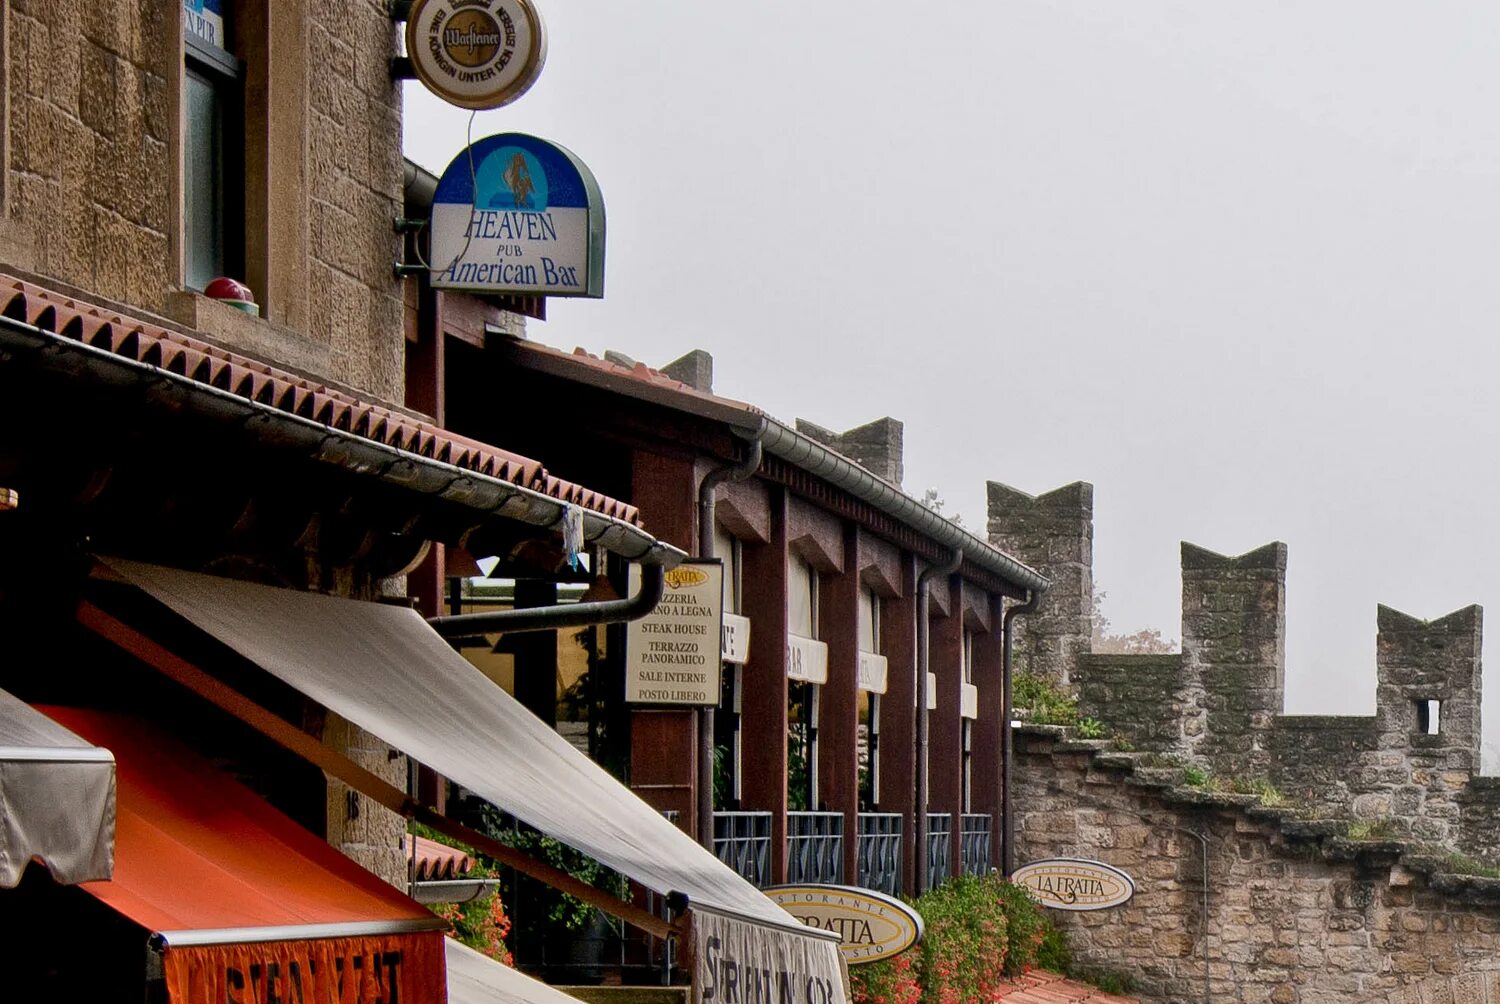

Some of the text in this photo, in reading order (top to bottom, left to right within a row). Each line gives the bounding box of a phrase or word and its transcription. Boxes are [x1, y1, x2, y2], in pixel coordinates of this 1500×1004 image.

[429, 8, 447, 34] EINE
[445, 22, 499, 55] Warsteiner
[428, 36, 458, 78] KÖNIGIN
[494, 48, 513, 72] DEN
[458, 68, 496, 82] UNTER
[463, 211, 558, 241] HEAVEN
[496, 244, 523, 257] PUB
[437, 255, 580, 287] American Bar
[659, 593, 697, 604] ZZERIA
[672, 606, 679, 616] A
[680, 606, 712, 617] LEGNA
[641, 623, 707, 635] STEAK HOUSE
[649, 641, 699, 653] TERRAZZO
[641, 653, 706, 665] PANORAMICO
[639, 671, 707, 683] SALE INTERNE
[639, 690, 706, 701] POSTO LIBERO
[1038, 875, 1105, 897] LA FRATTA
[778, 893, 886, 916] STORANTE
